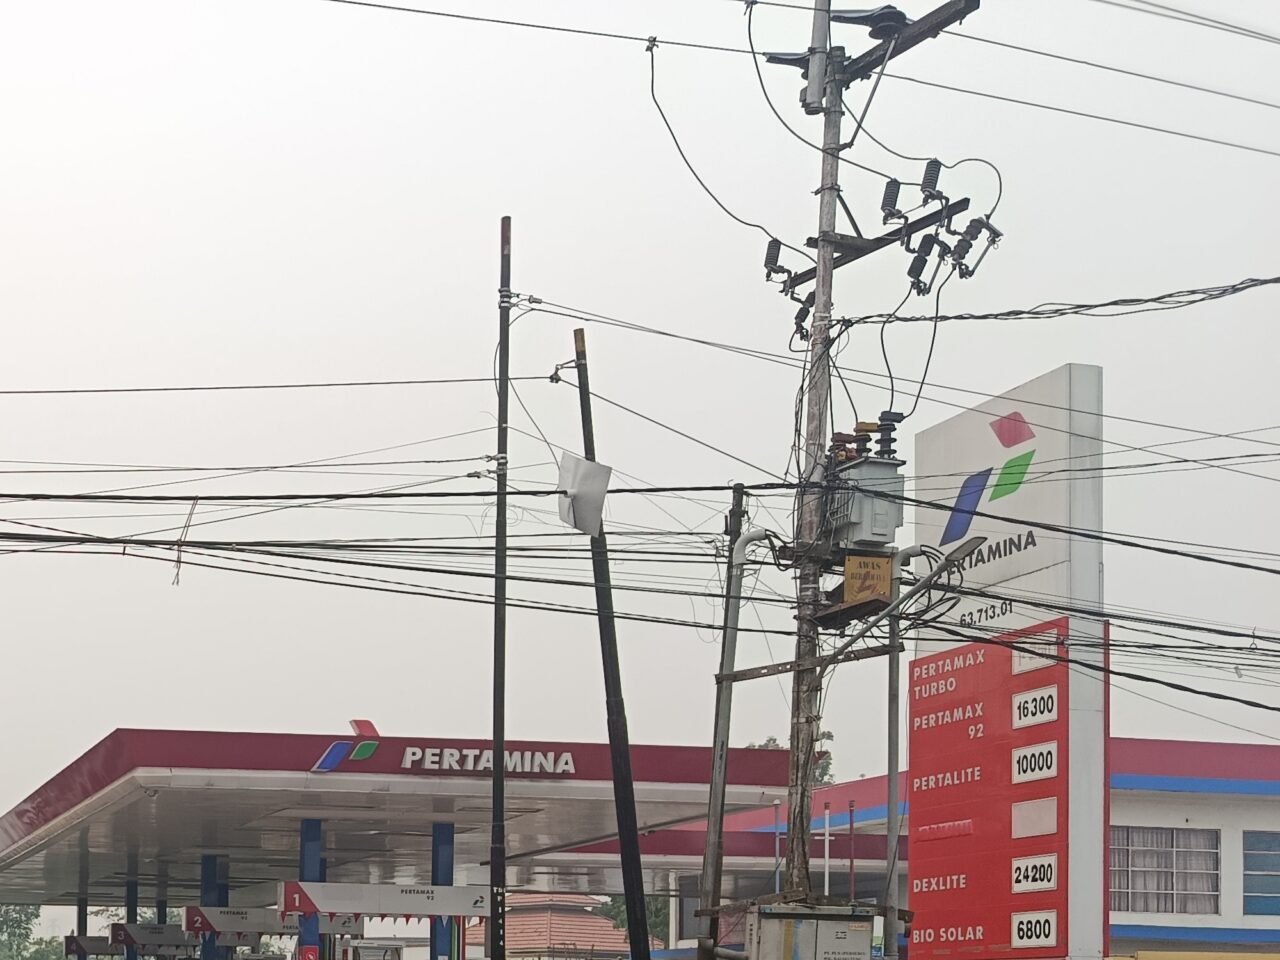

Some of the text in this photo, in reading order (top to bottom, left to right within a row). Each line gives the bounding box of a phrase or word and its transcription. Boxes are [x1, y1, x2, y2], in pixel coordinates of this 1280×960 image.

[960, 600, 1013, 626] 63.713.01
[913, 649, 985, 681] PERTAMAX
[913, 677, 956, 700] TURBO
[913, 702, 984, 732] PERTAMAX
[1017, 694, 1054, 720] 16300
[968, 723, 984, 740] 92
[401, 746, 576, 774] PERTAMINA
[1016, 750, 1053, 775] 10000
[913, 766, 982, 792] PERTALITE
[913, 874, 967, 893] DEXLITE
[1014, 863, 1053, 884] 24200
[292, 893, 300, 907] 1
[193, 916, 202, 927] 2
[1017, 918, 1052, 939] 6800
[118, 931, 124, 940] 3
[913, 925, 984, 944] BIO SOLAR
